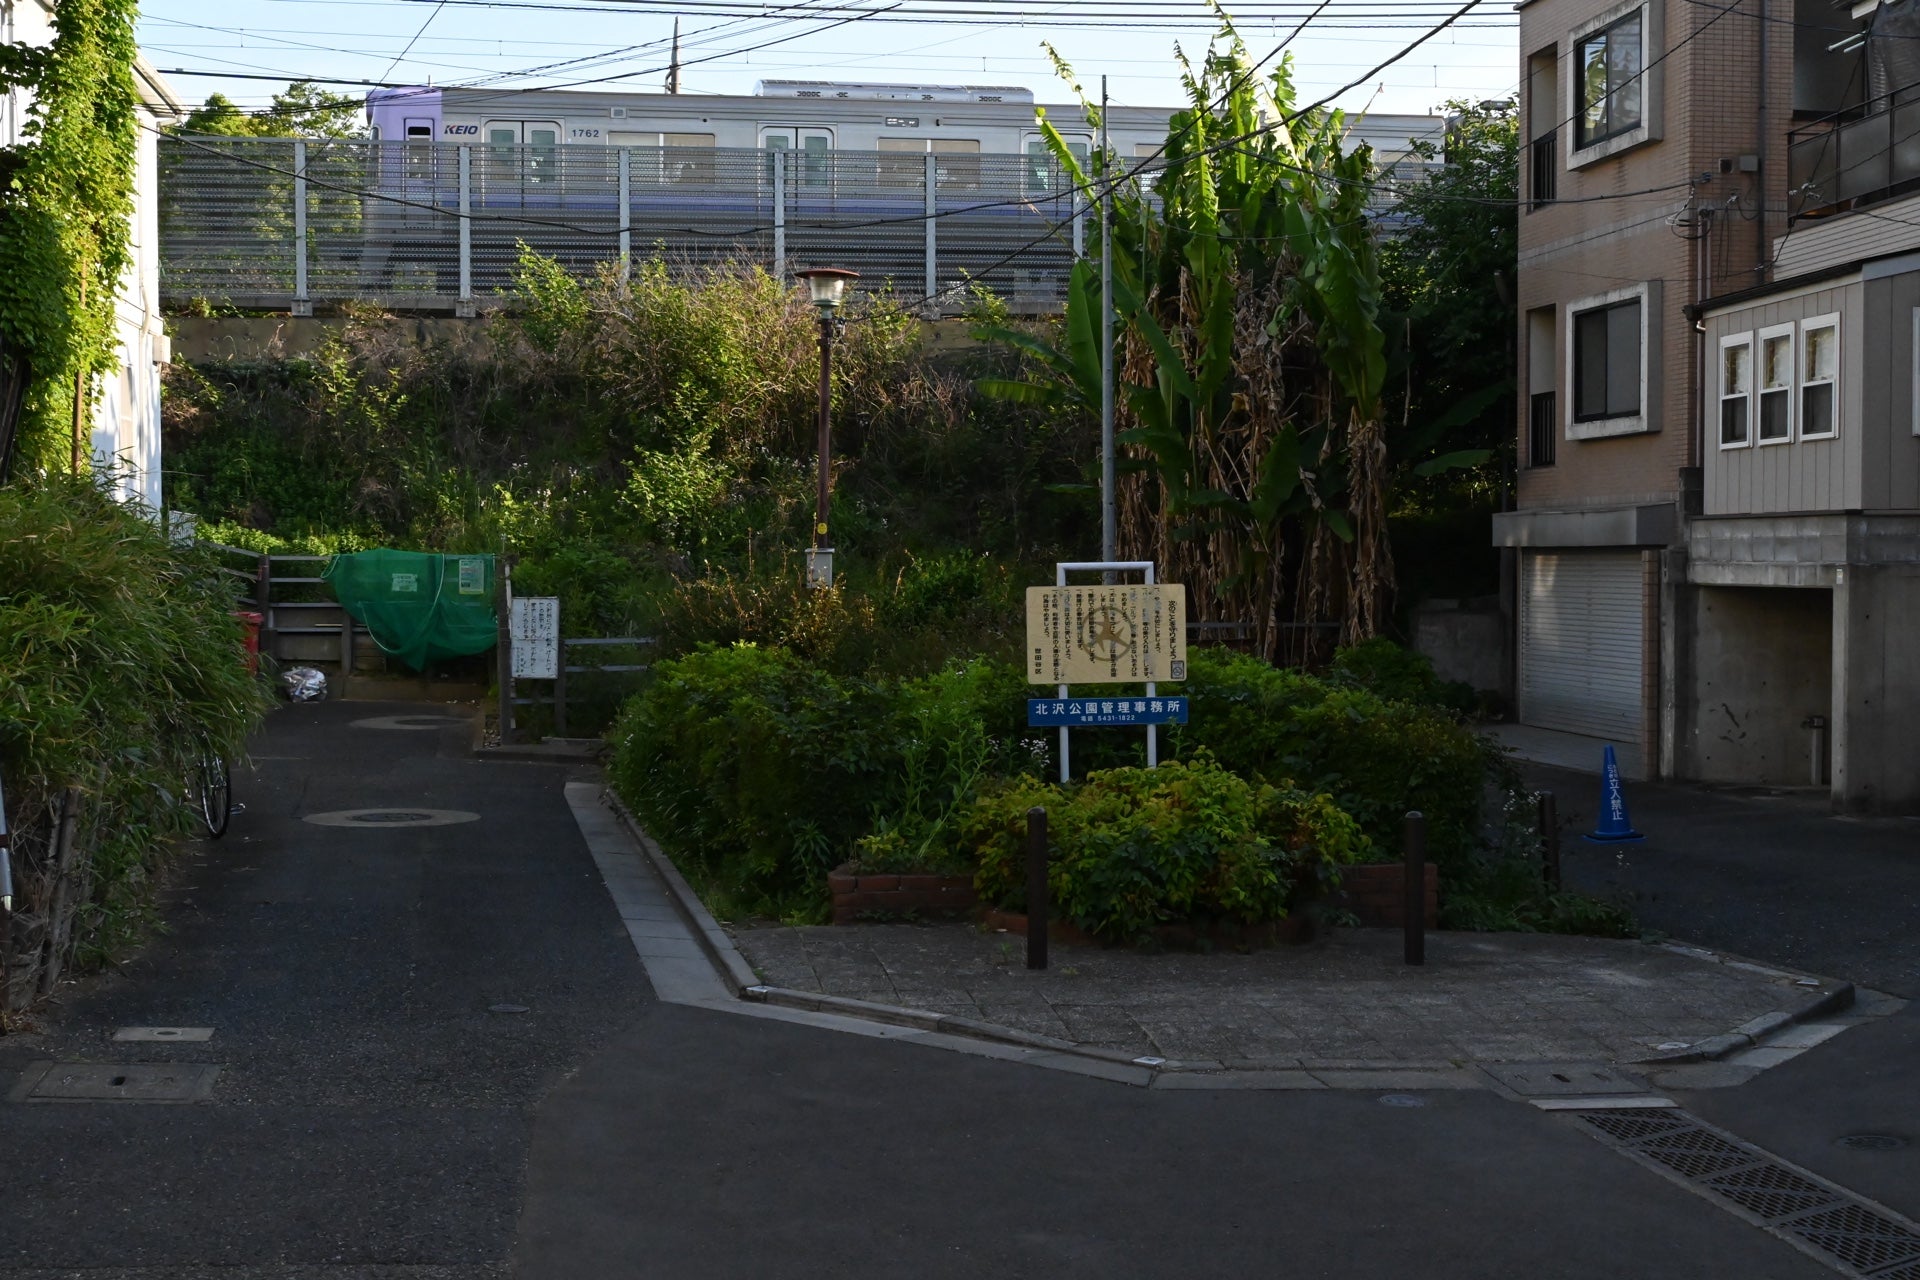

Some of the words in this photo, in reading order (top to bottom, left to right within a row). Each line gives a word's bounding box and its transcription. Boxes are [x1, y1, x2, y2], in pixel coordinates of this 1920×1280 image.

[444, 124, 478, 135] KEIO
[572, 129, 599, 138] 1762
[1034, 648, 1042, 674] 世田谷区
[1035, 700, 1180, 715] 北沢公園管理事務所
[1097, 714, 1135, 722] 5431-1822
[1609, 778, 1624, 820] 立入禁止
